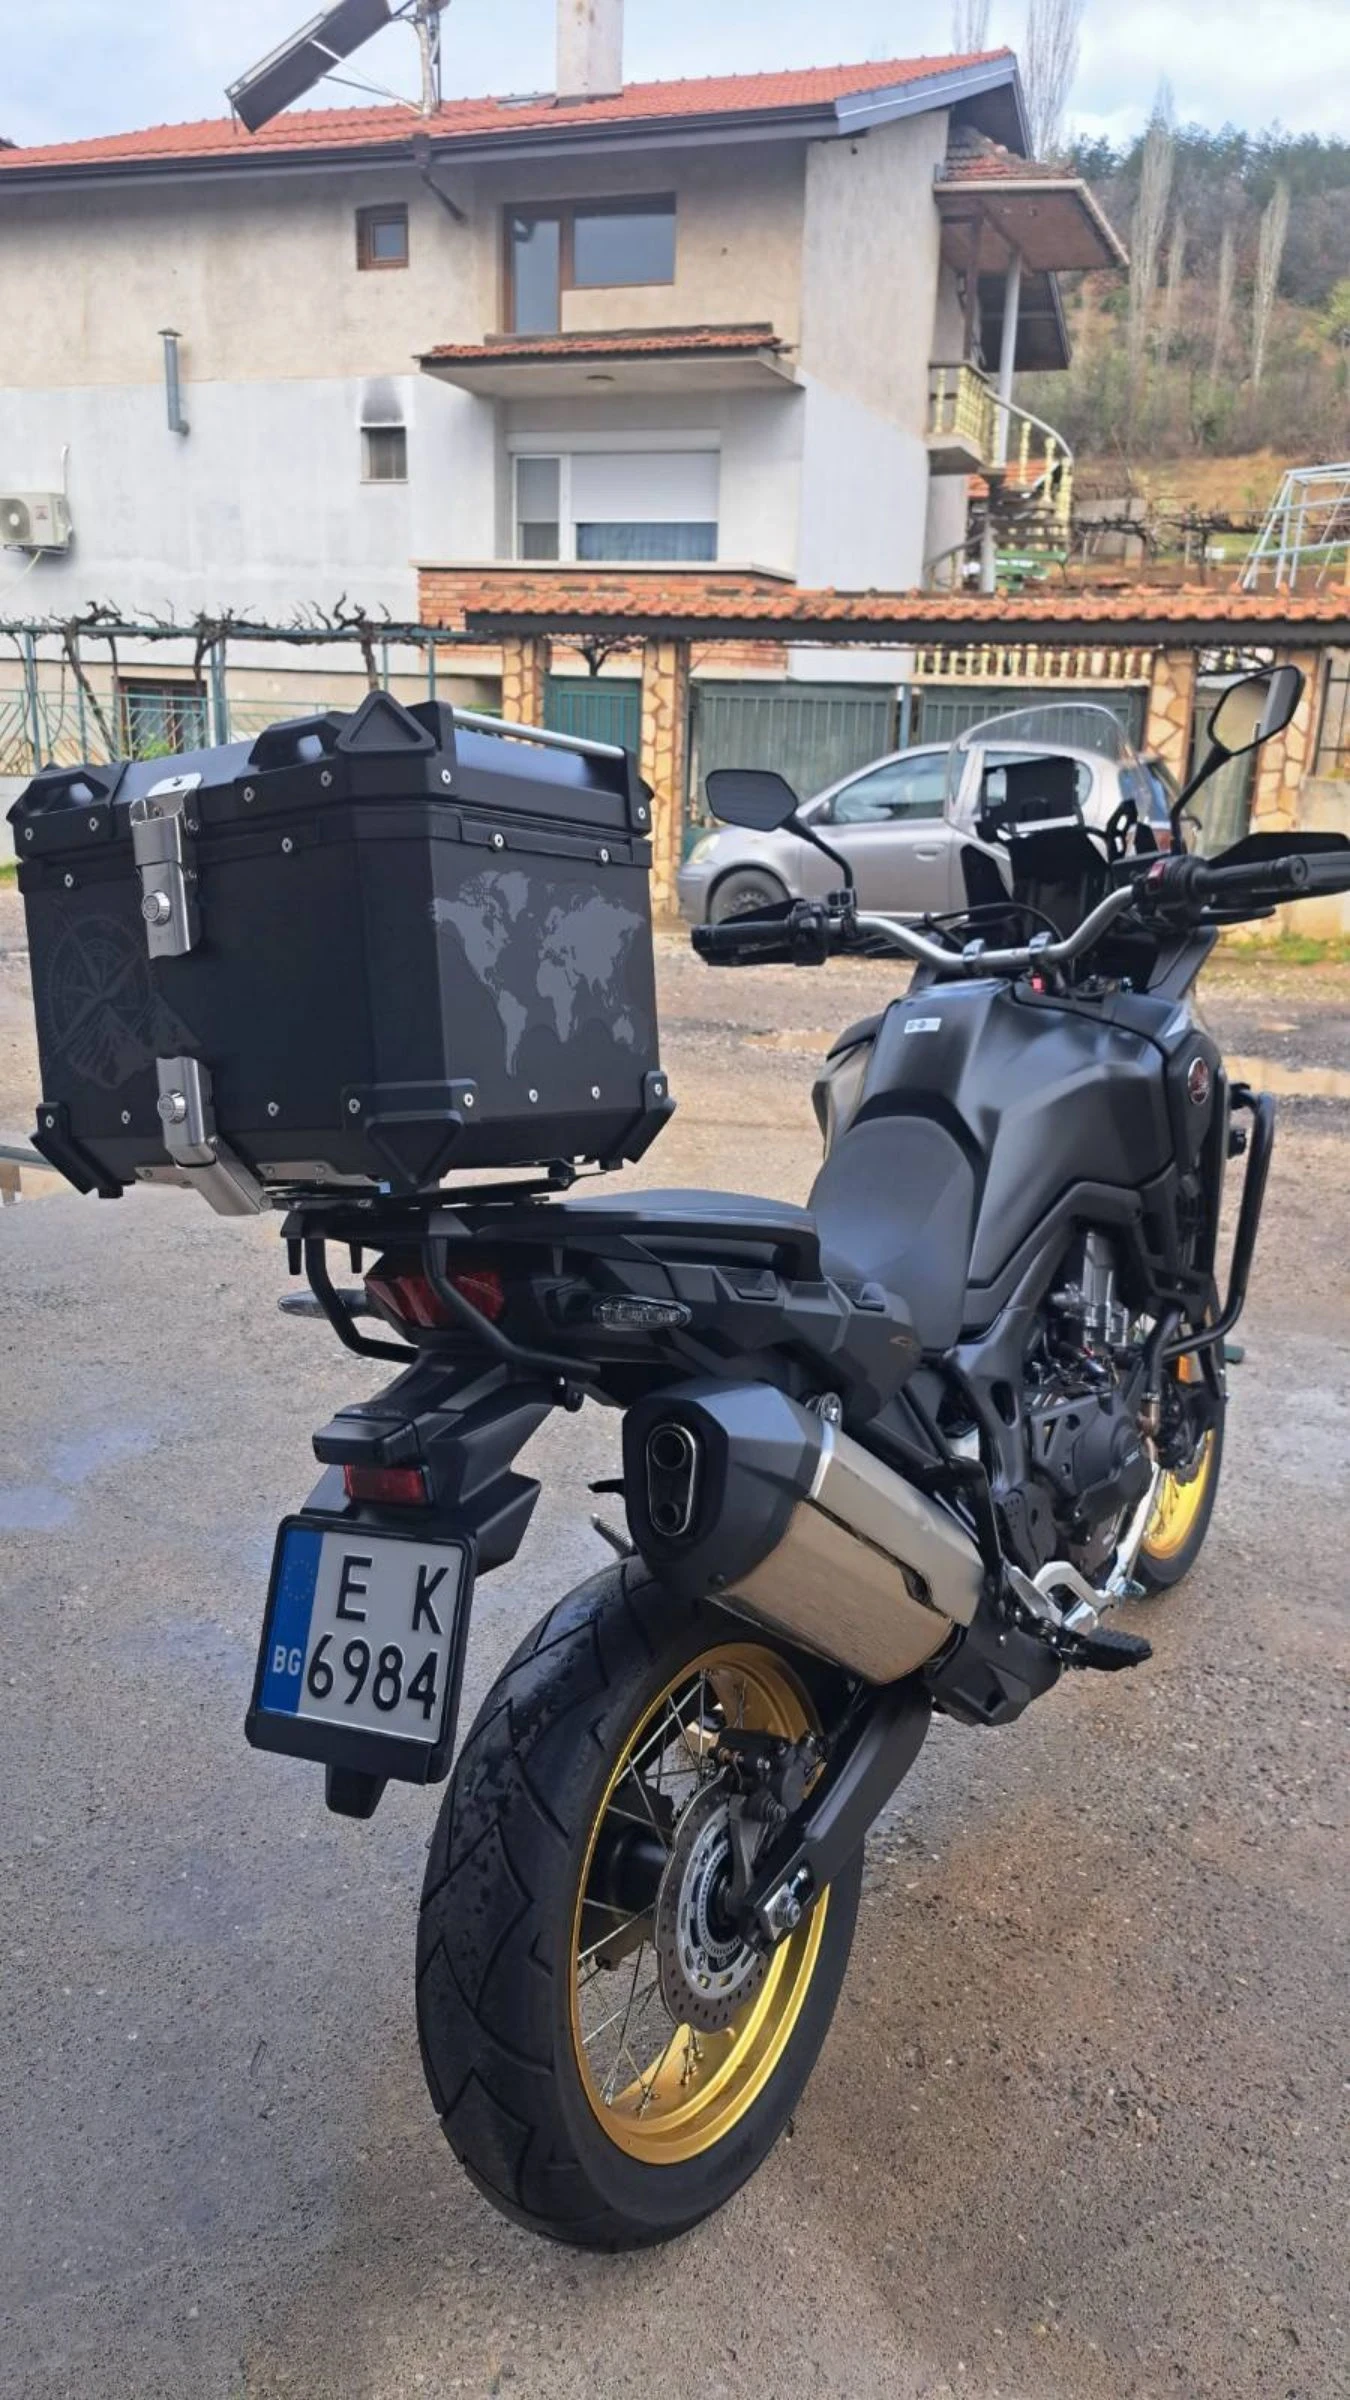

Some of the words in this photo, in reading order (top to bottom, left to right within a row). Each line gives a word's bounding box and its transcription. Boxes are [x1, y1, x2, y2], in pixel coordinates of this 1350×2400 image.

[336, 1554, 373, 1622] E
[411, 1564, 449, 1635] K
[272, 1645, 302, 1676] BG
[307, 1633, 439, 1720] 6984
